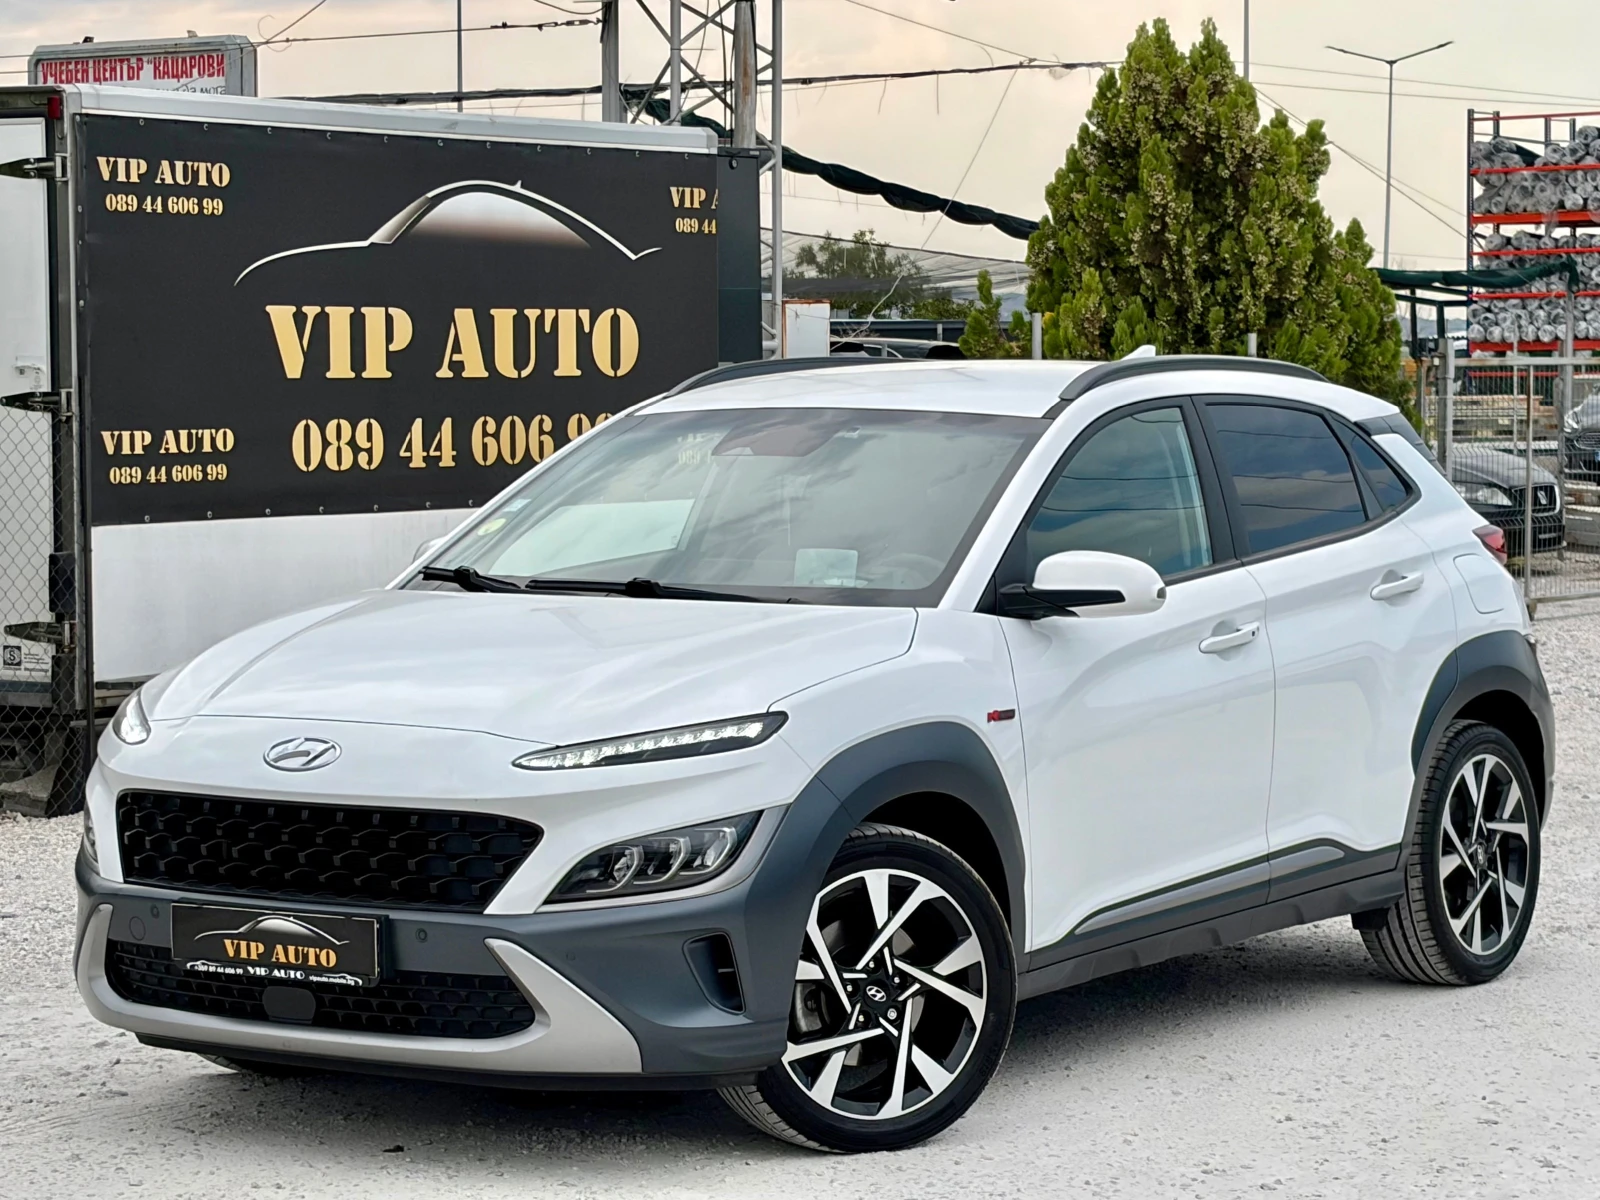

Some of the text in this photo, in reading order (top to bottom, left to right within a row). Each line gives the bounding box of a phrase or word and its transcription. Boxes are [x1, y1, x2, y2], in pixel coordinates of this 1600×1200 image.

[42, 60, 90, 85] УЧЕБЕН
[93, 57, 144, 85] ЦЕНТЪР
[97, 156, 231, 188] VIP AUTO
[105, 193, 224, 216] 089 44 606 99
[670, 186, 707, 209] VIP
[675, 217, 717, 234] 089 44
[265, 304, 640, 379] VIP AUTO
[101, 428, 235, 455] VIP AUTO
[291, 418, 384, 472] 089
[399, 416, 457, 469] 44
[471, 414, 555, 466] 606
[109, 463, 228, 485] 089 44 606 99
[223, 938, 337, 968] VIP AUTO
[247, 966, 270, 976] VIP
[271, 968, 305, 979] AUTO
